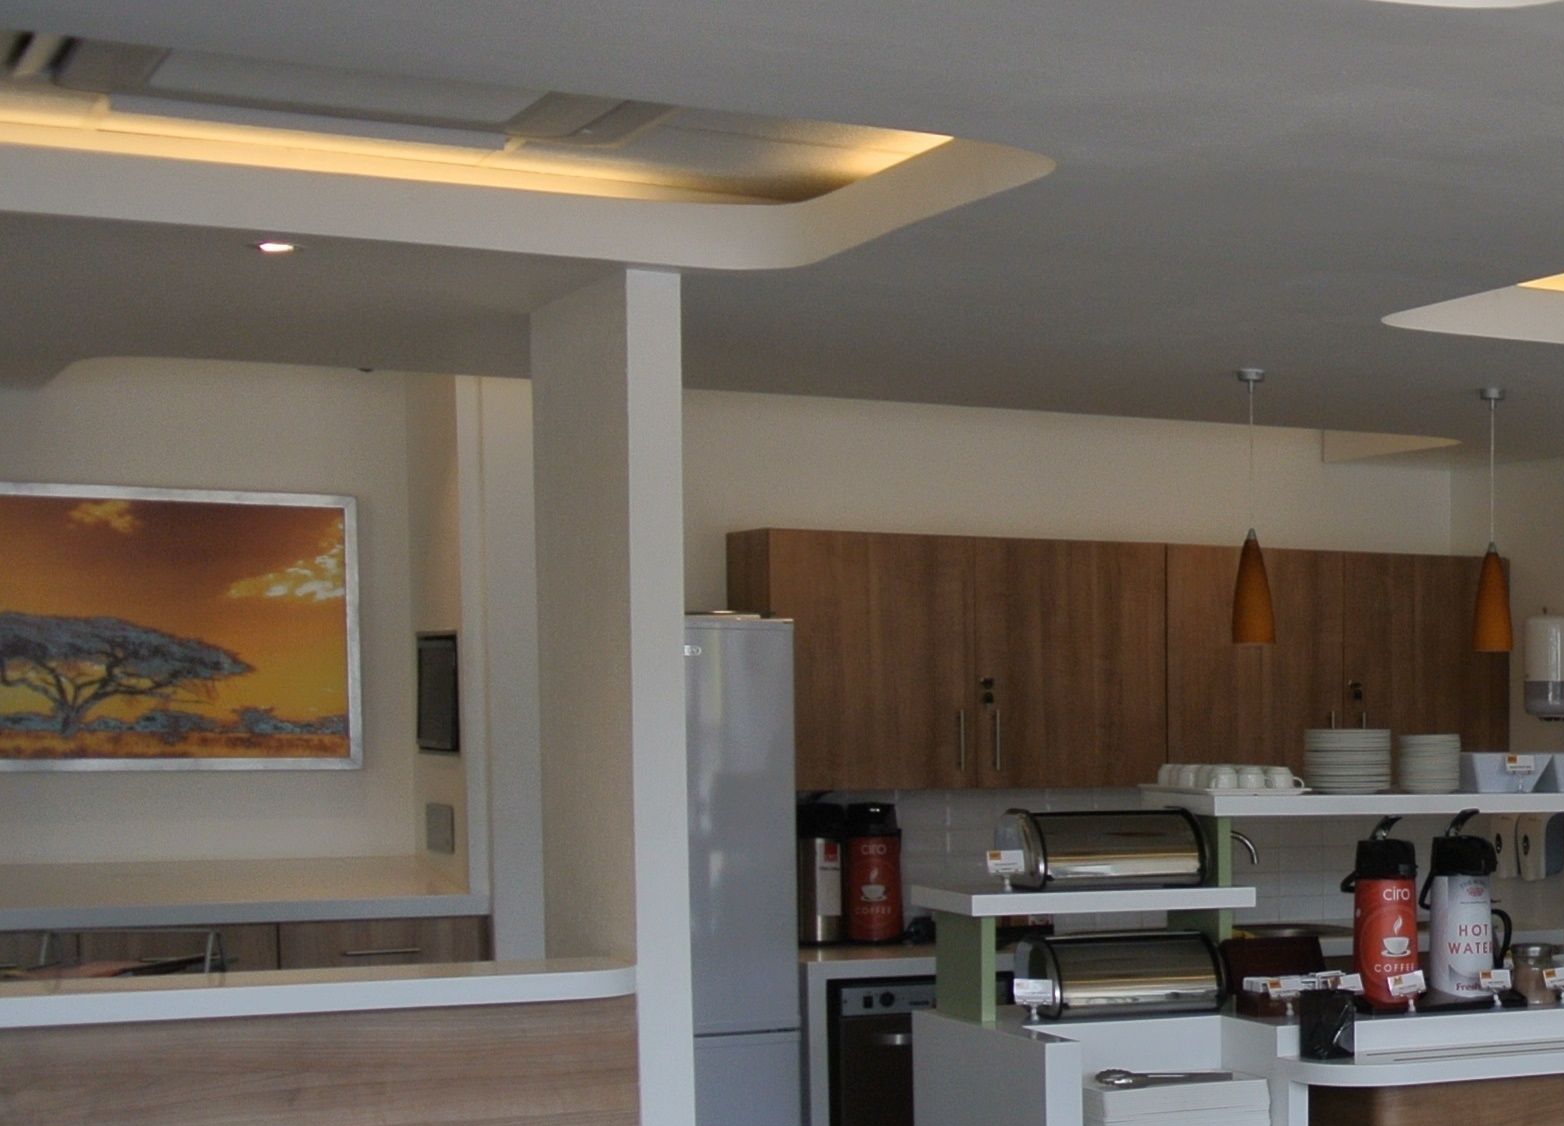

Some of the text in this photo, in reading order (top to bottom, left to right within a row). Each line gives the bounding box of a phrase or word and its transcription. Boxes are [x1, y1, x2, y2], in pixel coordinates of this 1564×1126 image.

[1382, 885, 1410, 901] ciro
[1458, 924, 1488, 937] HOT
[1374, 963, 1415, 973] COFFEE
